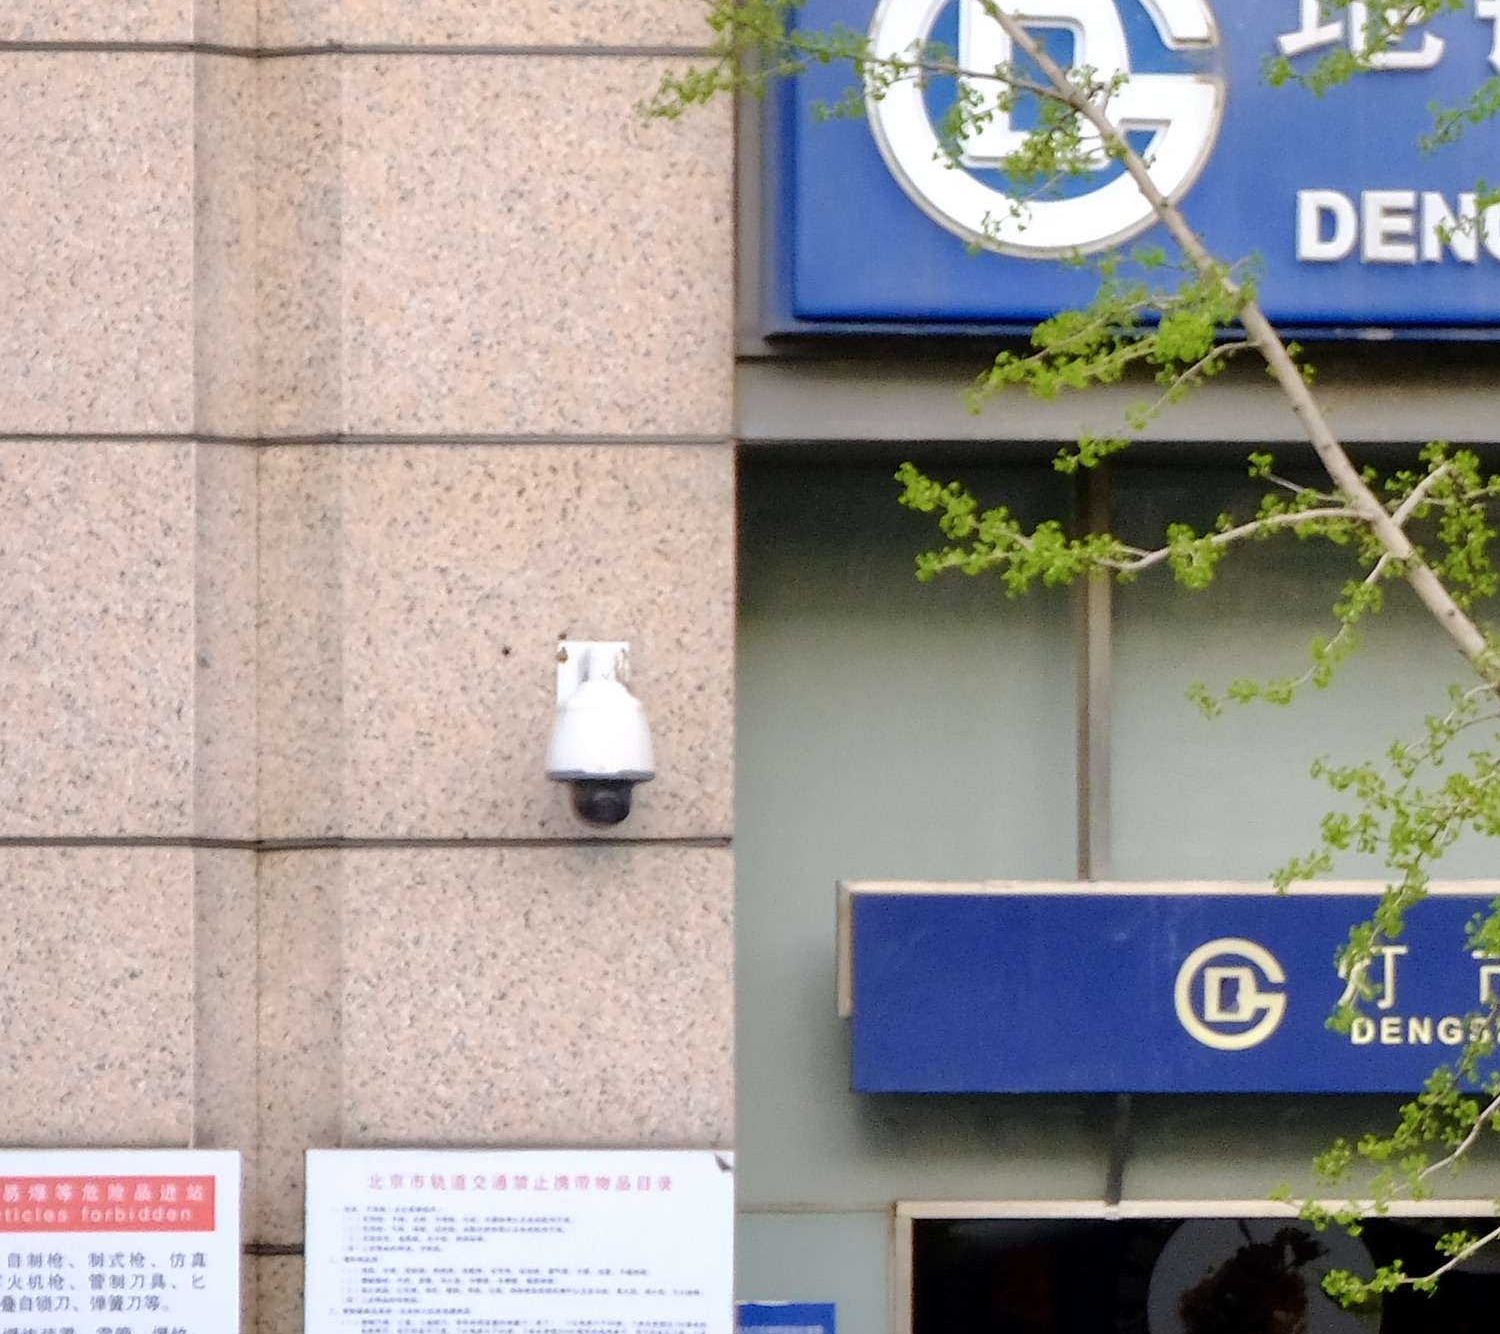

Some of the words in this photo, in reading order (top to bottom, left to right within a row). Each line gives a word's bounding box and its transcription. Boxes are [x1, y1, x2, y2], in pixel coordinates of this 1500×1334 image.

[0, 1206, 69, 1223] ticles
[81, 1205, 192, 1223] forbidden
[0, 1273, 206, 1290] 火机枪、管制刀具、匕
